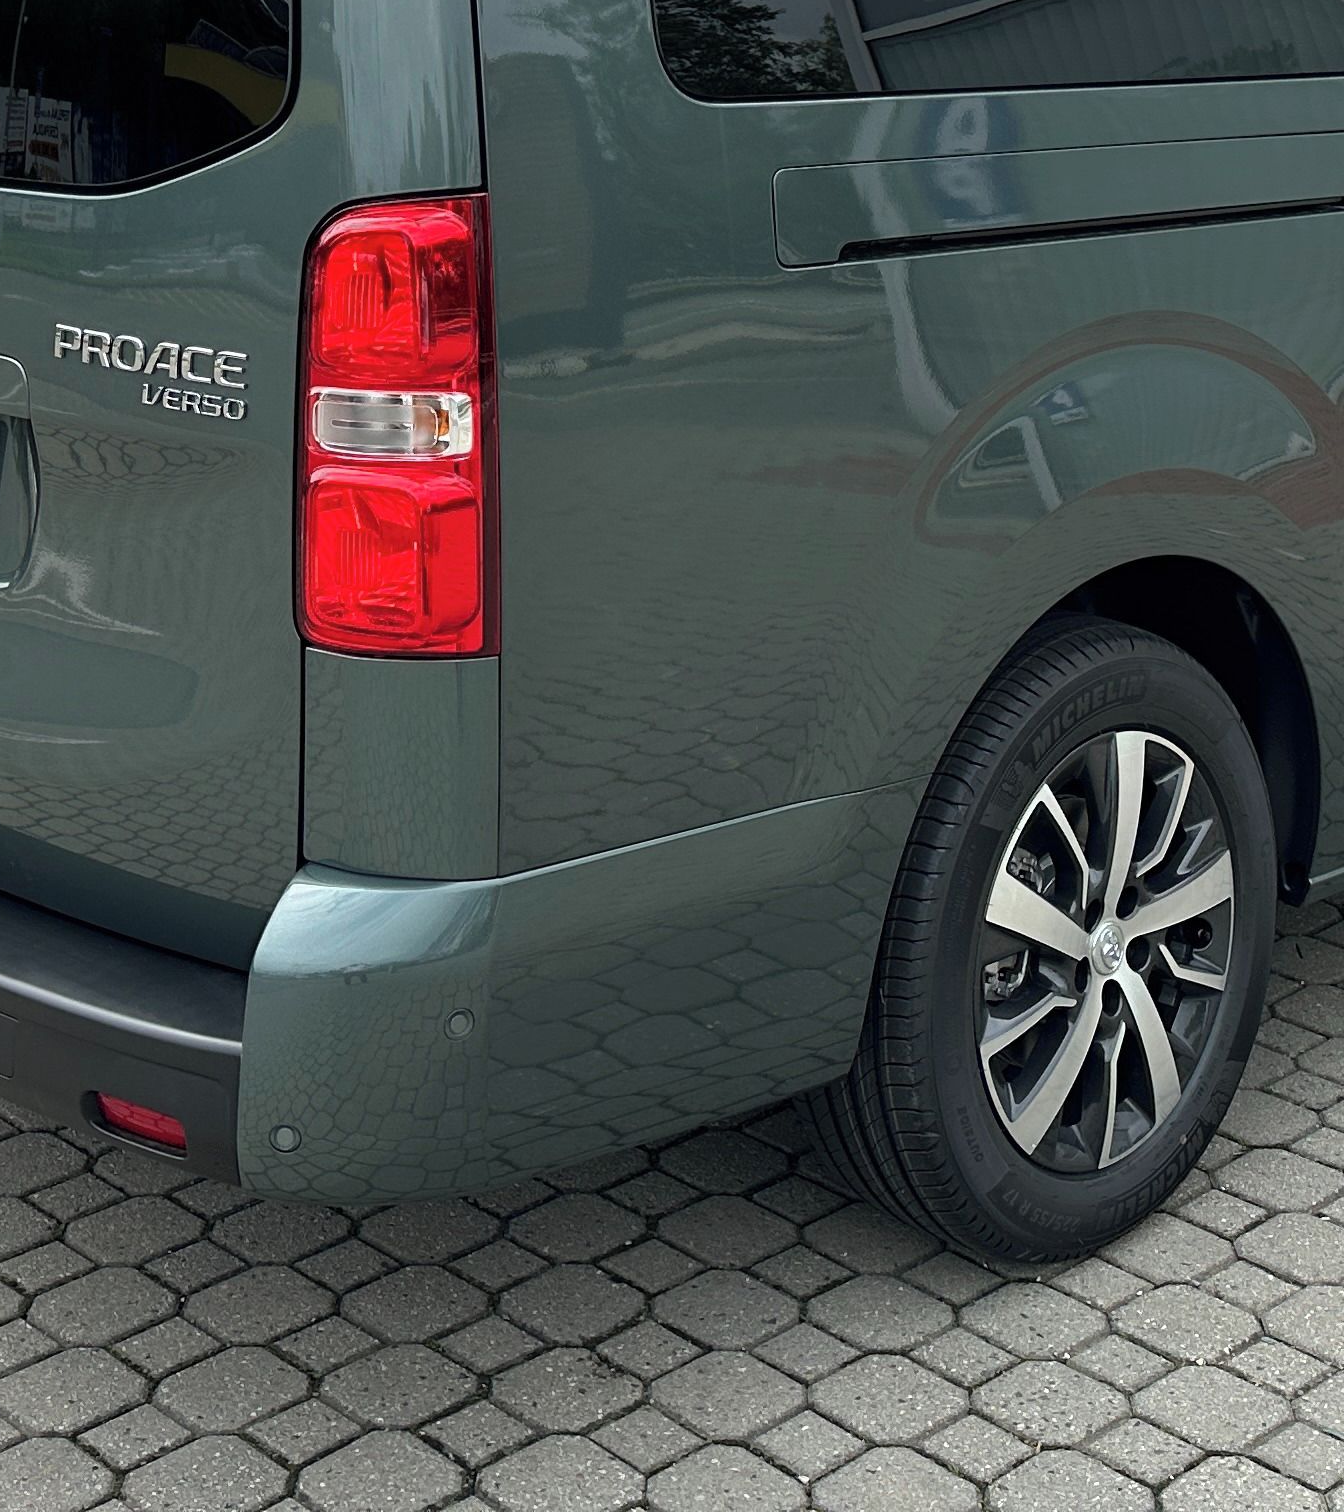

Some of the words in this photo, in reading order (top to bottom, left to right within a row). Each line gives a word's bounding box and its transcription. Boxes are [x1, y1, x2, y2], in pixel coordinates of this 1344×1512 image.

[54, 323, 248, 390] PROACE
[141, 383, 247, 420] VERSO
[1031, 674, 1145, 763] MICHELIN
